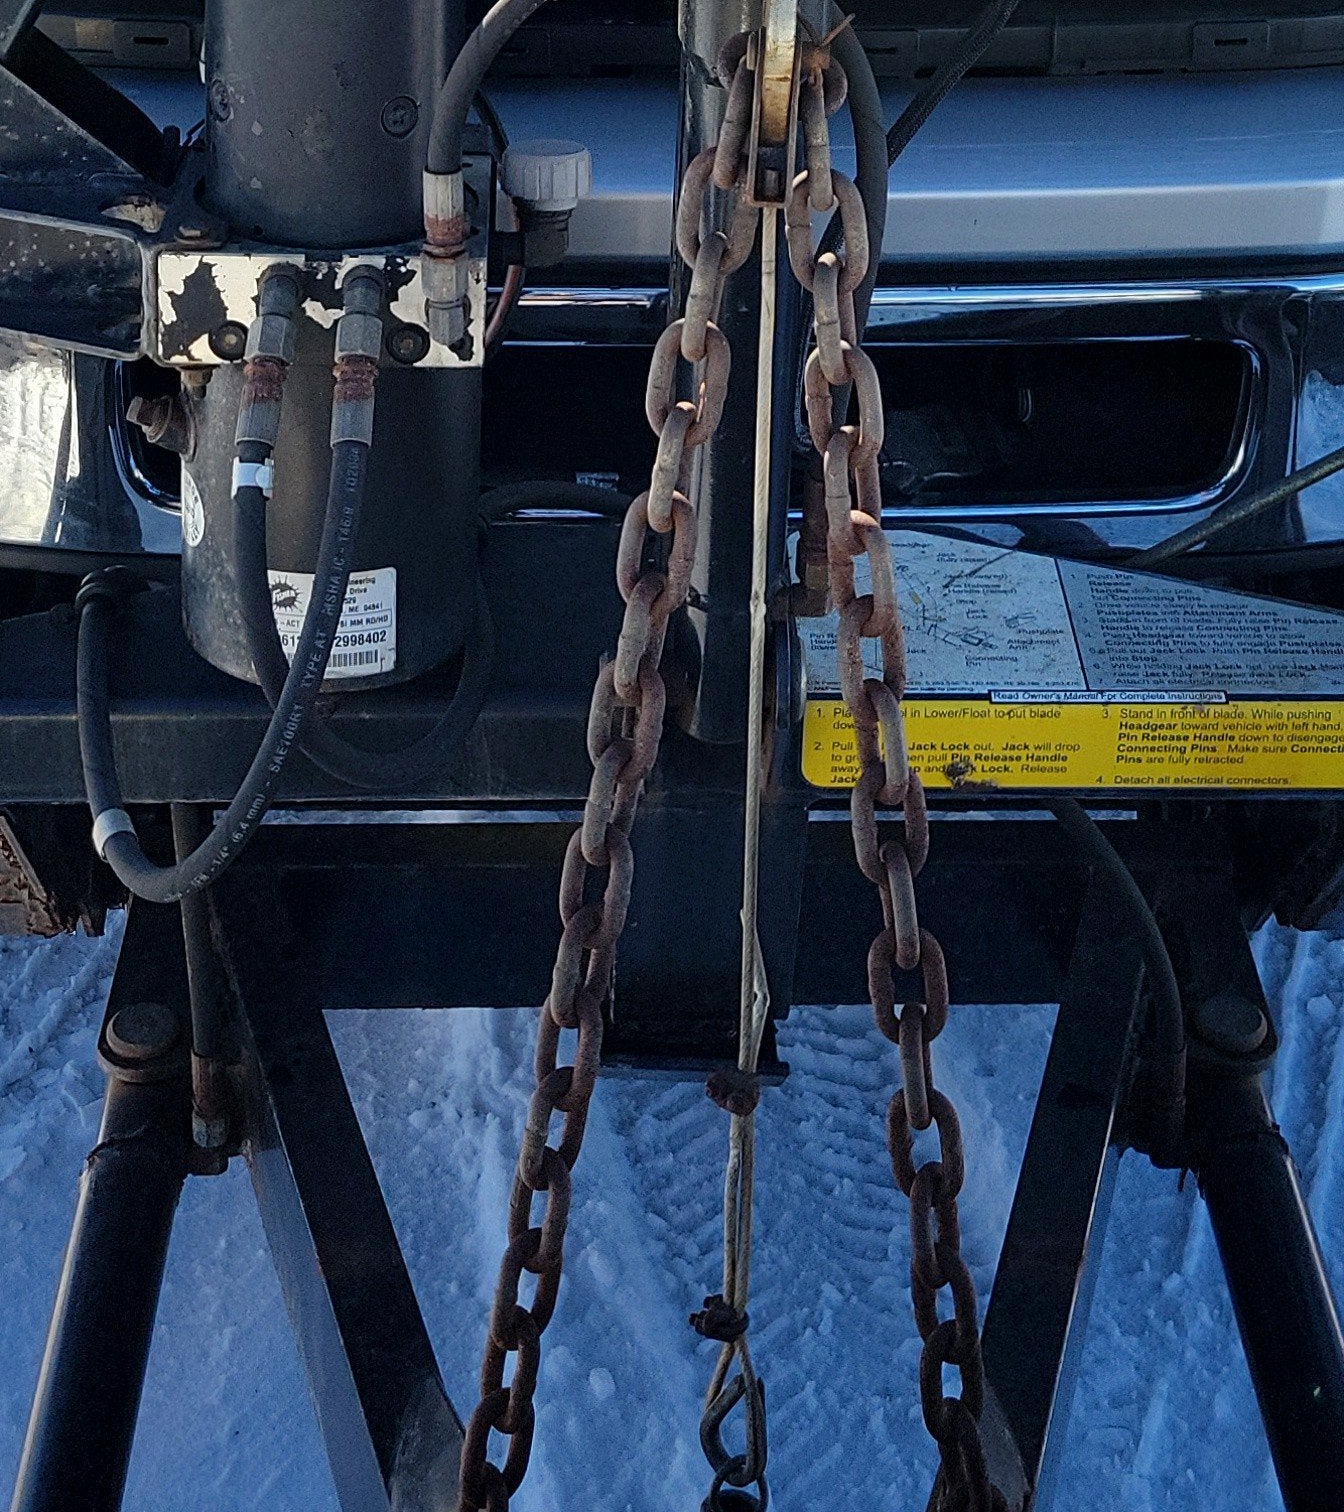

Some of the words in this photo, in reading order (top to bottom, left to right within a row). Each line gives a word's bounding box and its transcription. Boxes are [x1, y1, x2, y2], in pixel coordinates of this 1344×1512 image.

[994, 692, 1018, 700] Read
[1020, 692, 1060, 700] Owner's
[1101, 692, 1117, 700] For
[1119, 692, 1166, 702] Complete
[833, 708, 853, 719] Pla
[911, 708, 921, 719] in
[924, 708, 990, 719] Lower/Float
[994, 708, 1005, 719] to
[1007, 708, 1027, 721] put
[1030, 708, 1061, 719] blade
[1120, 708, 1153, 719] Stand
[1156, 708, 1167, 719] in
[1170, 708, 1196, 719] front
[1199, 708, 1210, 719] of
[1252, 708, 1283, 719] While
[1287, 710, 1331, 721] pushing
[833, 720, 856, 730] dow
[1119, 721, 1178, 732] Headgear
[1181, 721, 1219, 731] toward
[1223, 721, 1261, 731] vehicle
[1266, 721, 1288, 731] with
[1291, 721, 1309, 731] left
[1118, 733, 1137, 742] Pin
[1141, 733, 1189, 742] Release
[1193, 733, 1235, 742] Handle
[1239, 733, 1270, 742] down
[1273, 733, 1282, 742] to
[832, 741, 853, 751] Pull
[908, 741, 936, 751] Jack
[941, 741, 969, 751] Lock
[1002, 741, 1030, 751] Jack
[1033, 741, 1051, 751] will
[1054, 741, 1081, 754] drop
[1117, 744, 1187, 754] Connecting
[1227, 744, 1259, 753] Make
[831, 753, 842, 762] to
[927, 753, 947, 763] pull
[951, 753, 971, 762] Pin
[974, 753, 1022, 762] Release
[1025, 753, 1068, 762] Handle
[1116, 755, 1142, 764] Pins
[1146, 755, 1165, 764] are
[1168, 755, 1190, 766] fully
[831, 765, 860, 774] away
[924, 765, 946, 773] and
[981, 765, 1014, 773] Lock.
[1020, 765, 1067, 773] Release
[1114, 776, 1154, 784] Detach
[1157, 776, 1170, 784] all
[1173, 776, 1223, 784] electrical
